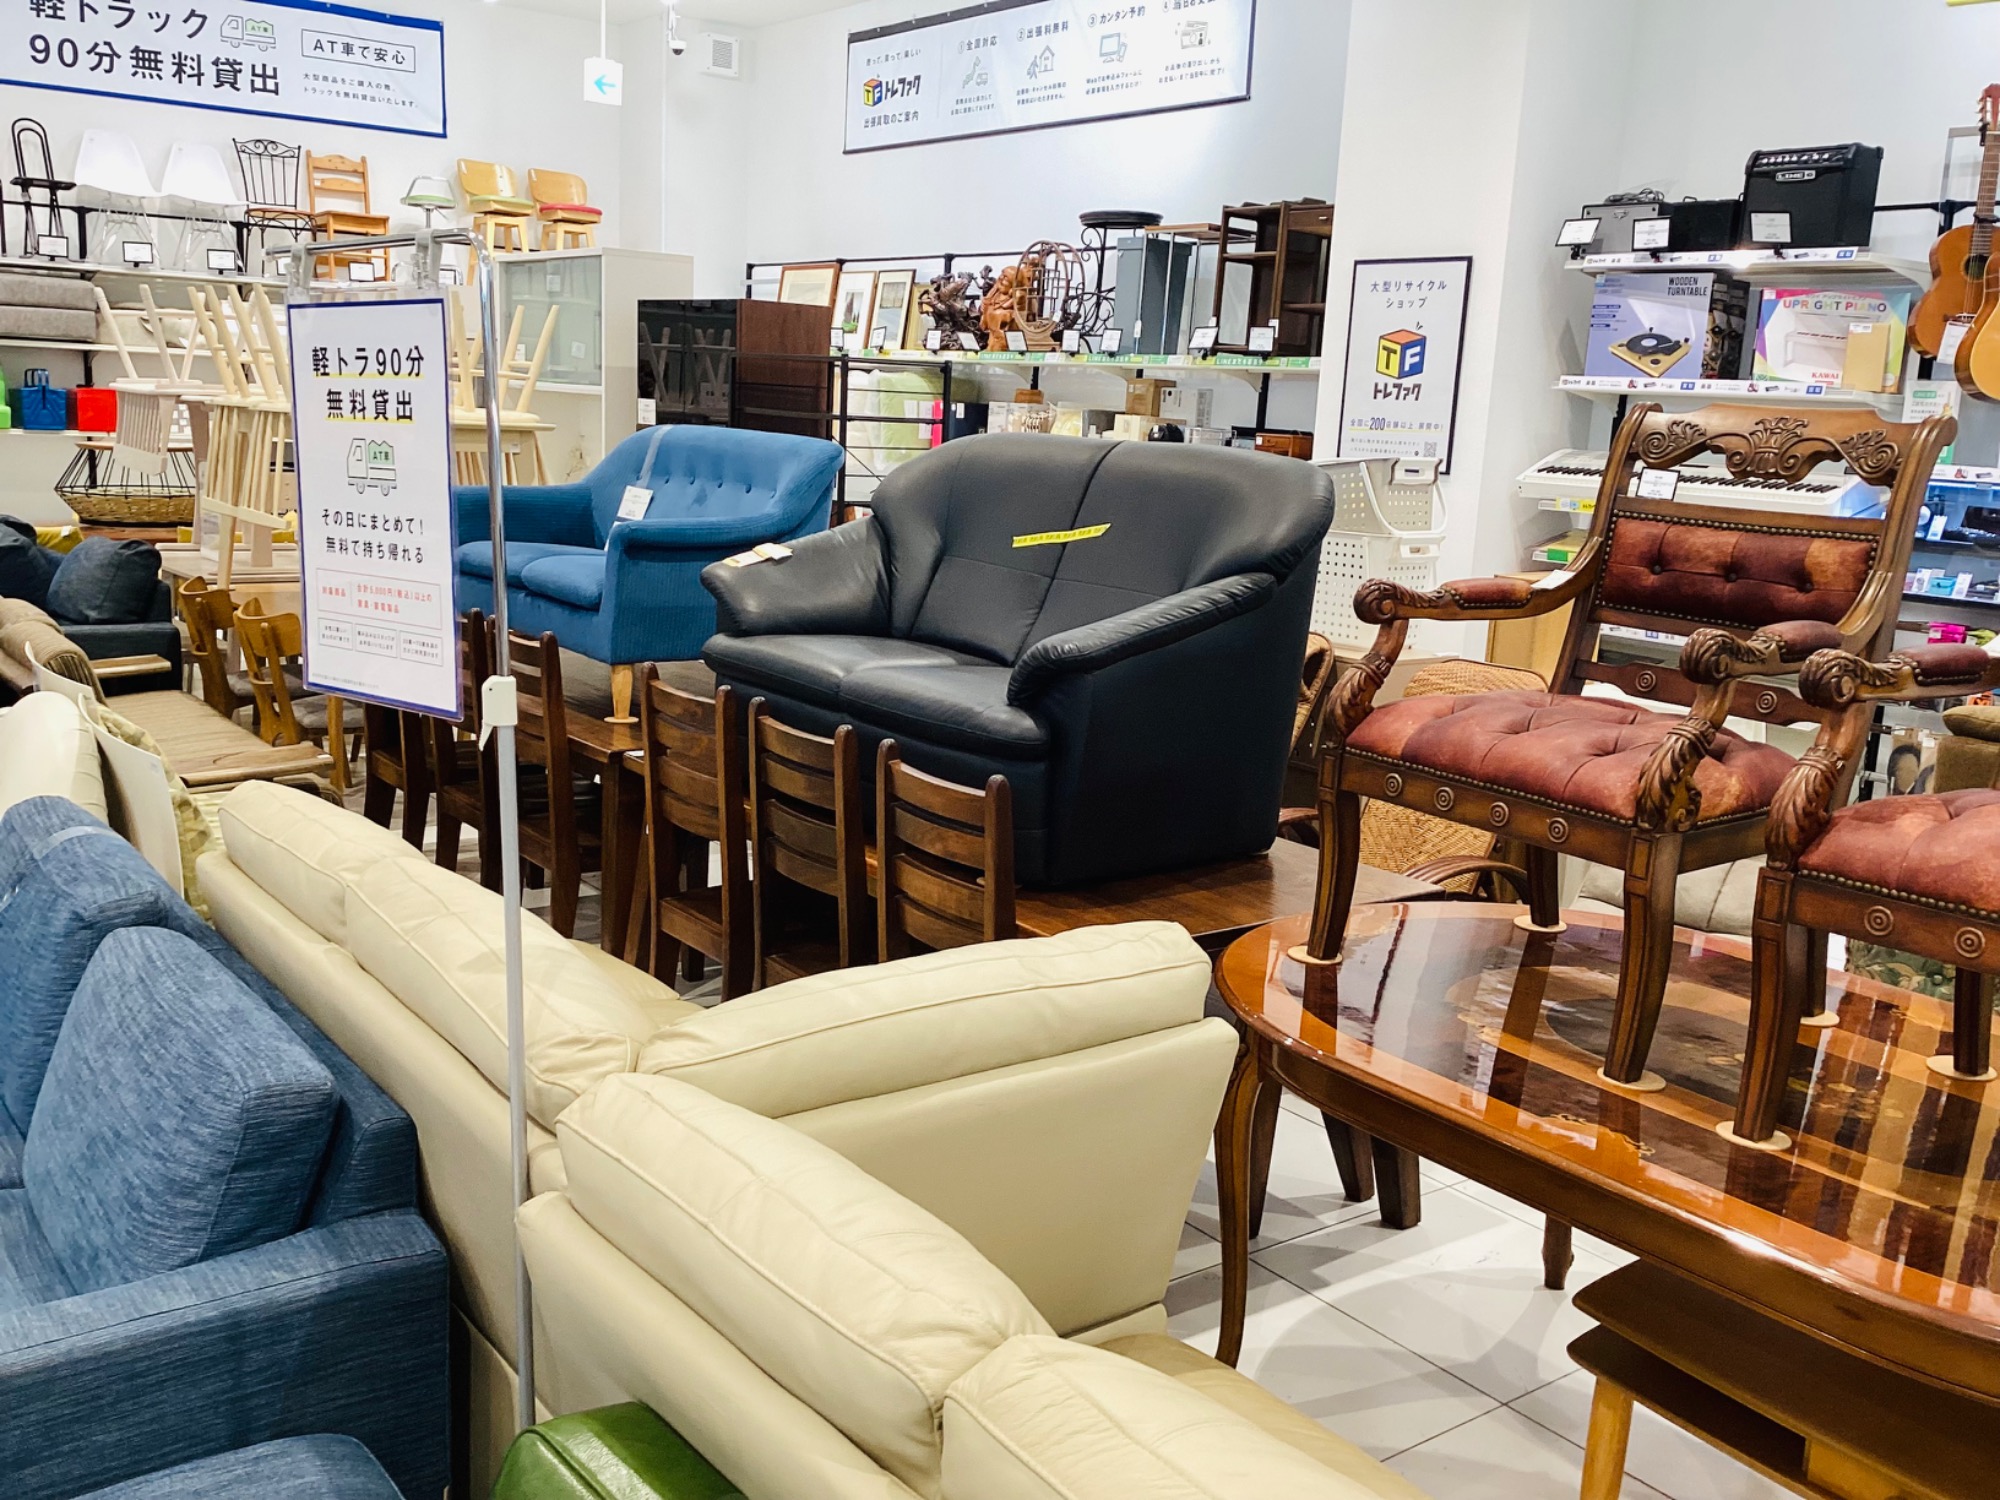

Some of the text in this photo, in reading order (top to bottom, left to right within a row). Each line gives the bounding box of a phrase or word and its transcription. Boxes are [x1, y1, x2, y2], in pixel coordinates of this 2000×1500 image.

[29, 0, 208, 38] 軽トラック
[313, 38, 406, 65] AT車で安心
[29, 34, 280, 96] 90分無料貸出
[1370, 280, 1447, 293] 大型リサイクル
[1667, 286, 1708, 296] TURNTABLE
[1669, 276, 1699, 286] WOODEN
[1386, 296, 1428, 309] ショップ
[1783, 299, 1887, 313] UPRGHT PIANO
[312, 345, 424, 377] 軽トラ90分
[1812, 371, 1839, 379] KAWAI
[1373, 382, 1423, 401] トレファク
[327, 388, 413, 421] 無料貸出
[321, 508, 424, 535] その日にまとめて!
[326, 536, 424, 564] 無料で持ち帰れる
